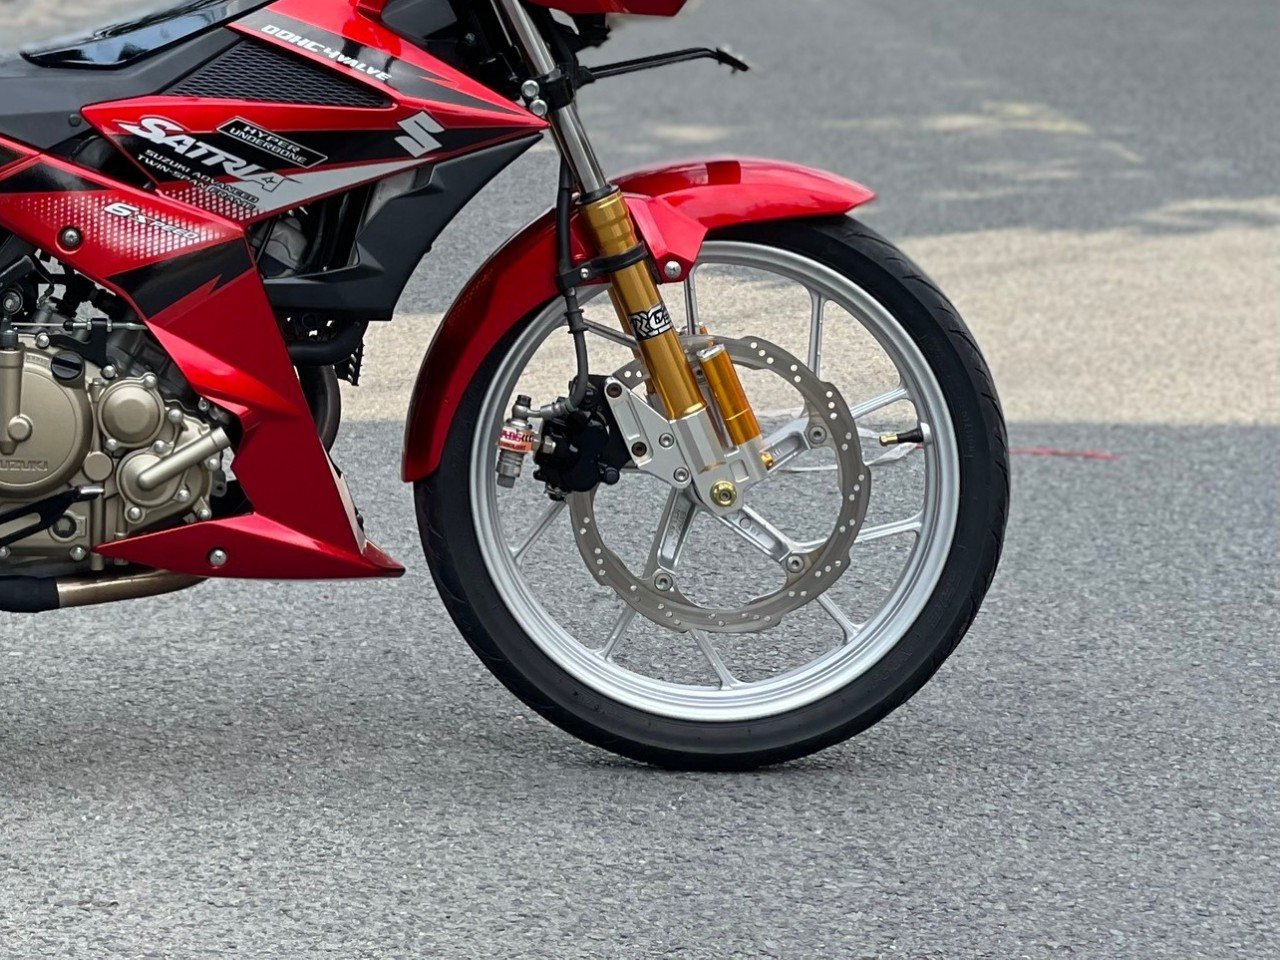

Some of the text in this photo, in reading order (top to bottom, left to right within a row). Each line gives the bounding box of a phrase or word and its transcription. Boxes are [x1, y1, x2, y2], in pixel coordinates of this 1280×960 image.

[118, 117, 292, 193] SATRIA
[229, 128, 308, 165] UNDERBONE
[243, 125, 301, 153] HYPER
[145, 149, 260, 204] SUZUKI ADVANCED
